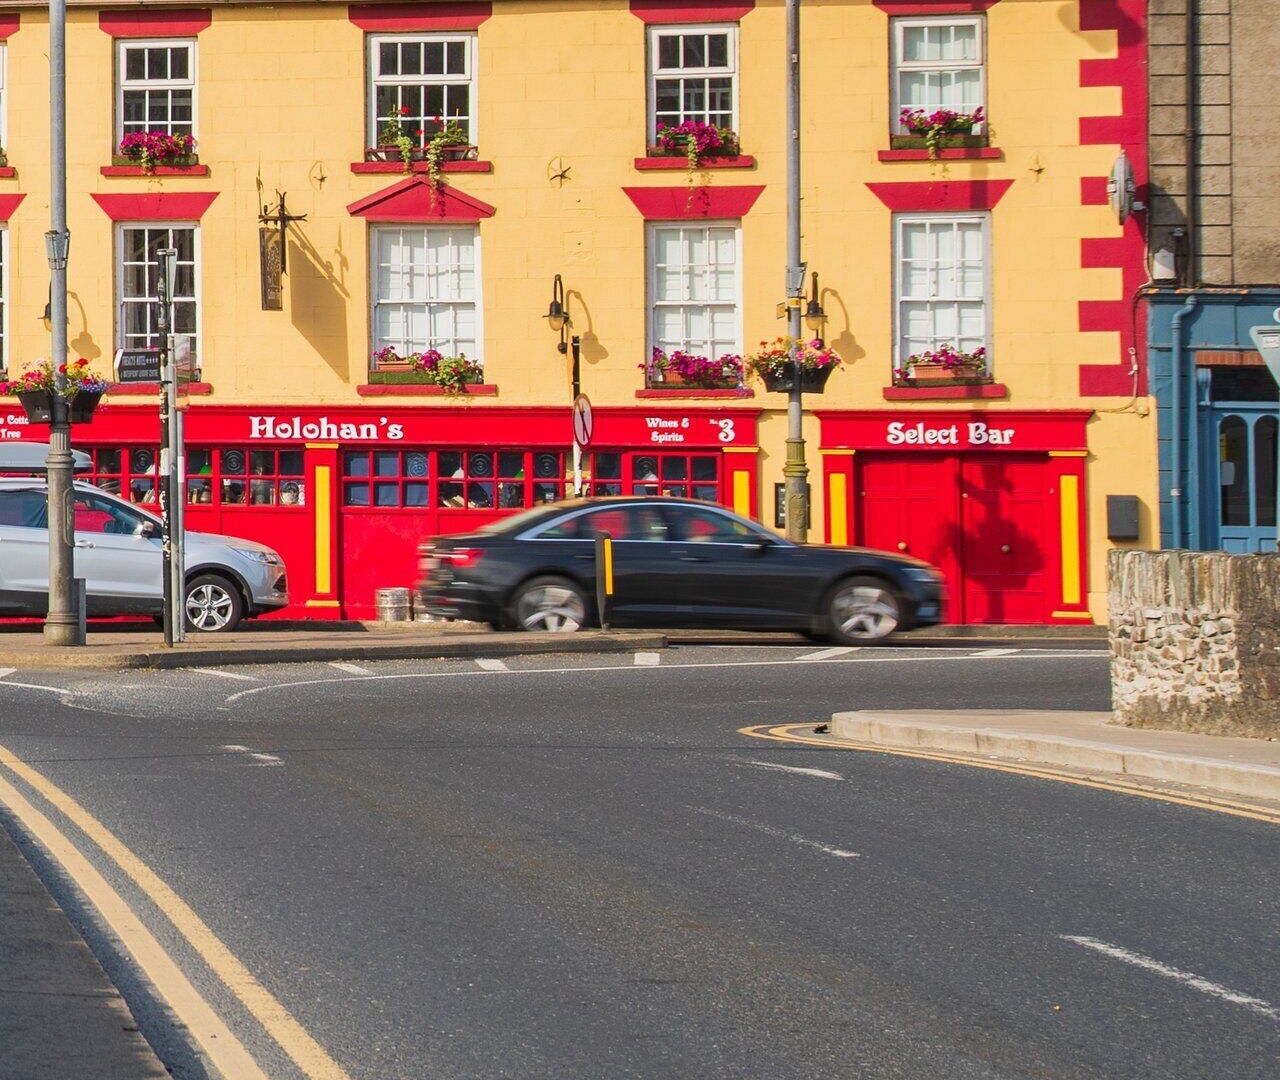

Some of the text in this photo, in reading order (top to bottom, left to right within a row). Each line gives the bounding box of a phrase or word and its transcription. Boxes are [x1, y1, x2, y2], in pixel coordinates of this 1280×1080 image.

[248, 416, 404, 440] Holohan's
[645, 417, 690, 429] Wines &
[718, 418, 736, 442] 3
[0, 428, 22, 438] Tree
[650, 430, 685, 443] Spirits
[886, 421, 1016, 445] Select Bar
